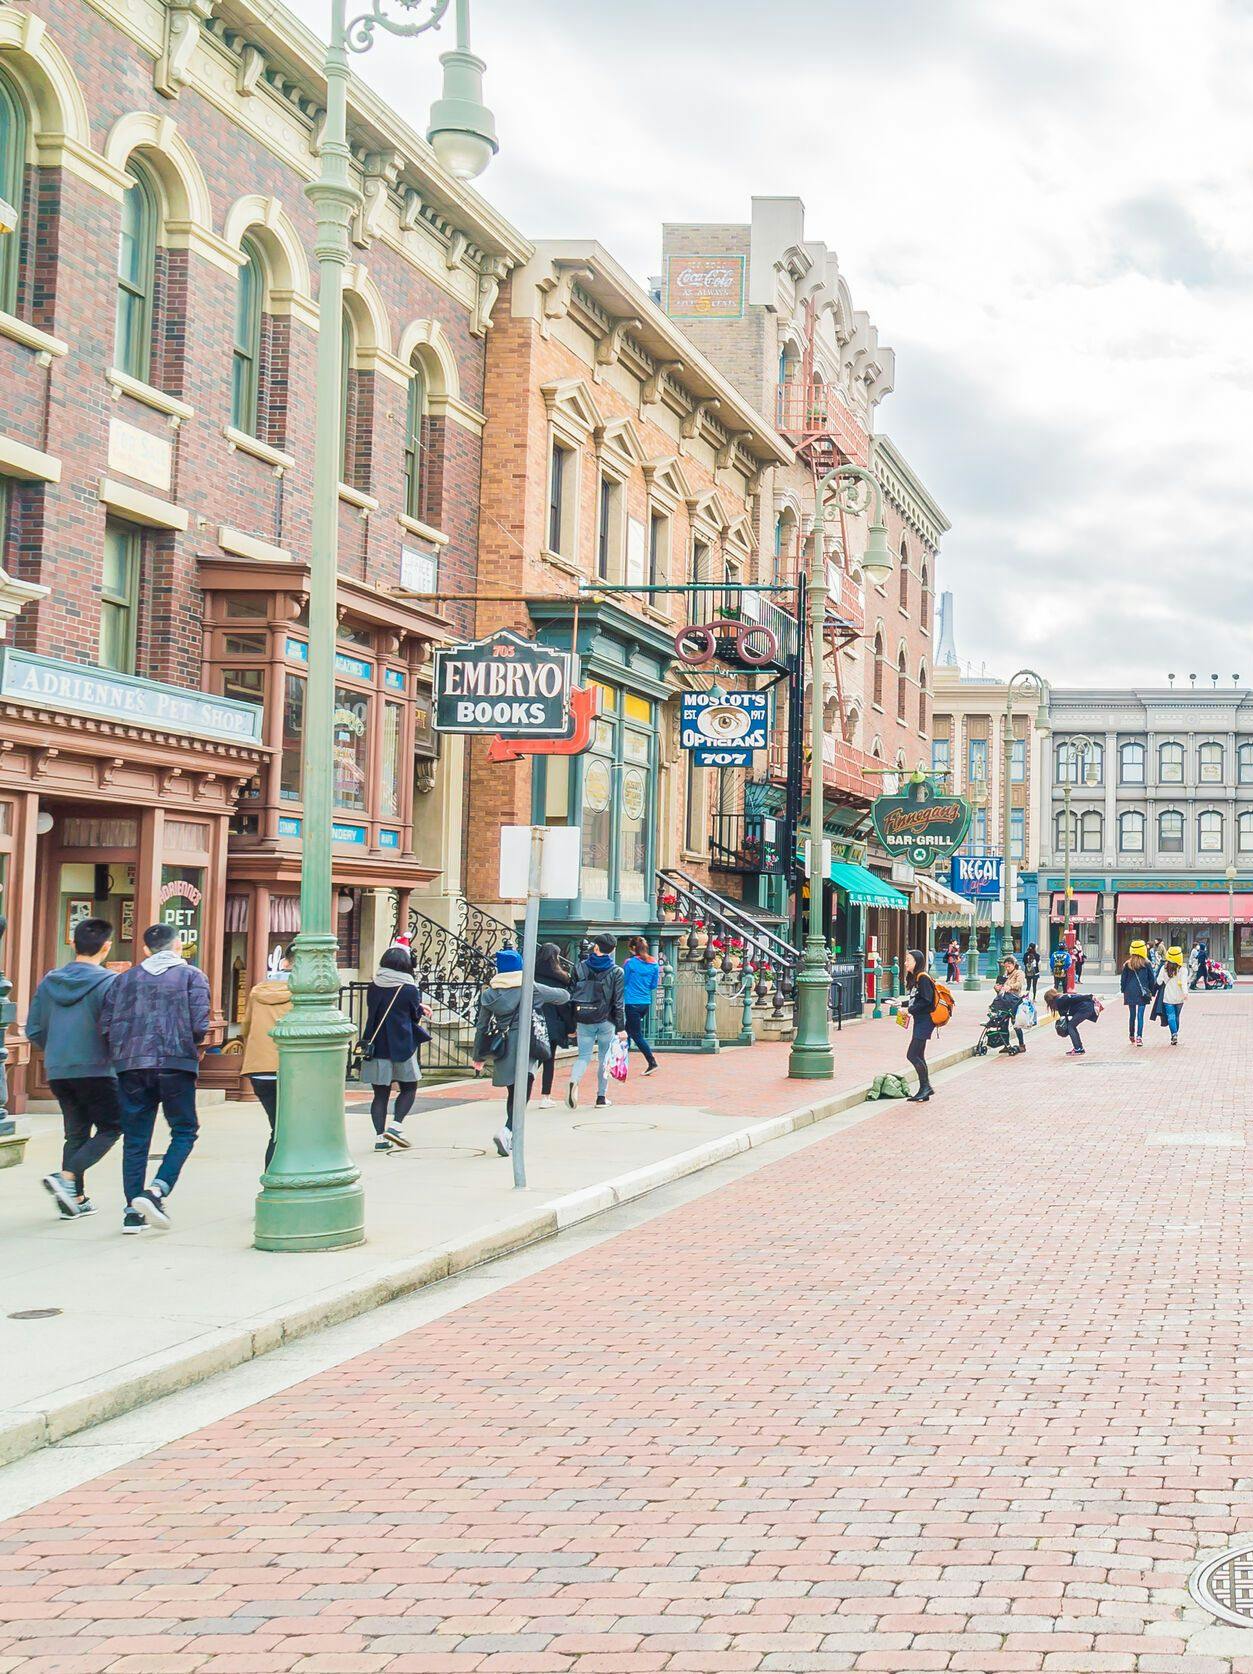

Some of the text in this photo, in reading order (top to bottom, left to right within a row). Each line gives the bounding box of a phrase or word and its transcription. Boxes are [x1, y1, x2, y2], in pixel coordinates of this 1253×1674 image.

[492, 645, 516, 658] 705
[443, 661, 563, 698] EMBRYO
[22, 666, 244, 731] ADRIENNE'S PET SHOP
[684, 694, 766, 706] MOSCOT'S
[457, 702, 546, 724] BOOKS
[751, 710, 766, 720] 1917
[683, 729, 766, 748] OPTICIANS
[701, 753, 747, 765] 707
[959, 859, 999, 881] REGAL
[165, 909, 195, 926] PET
[178, 929, 198, 944] OP
